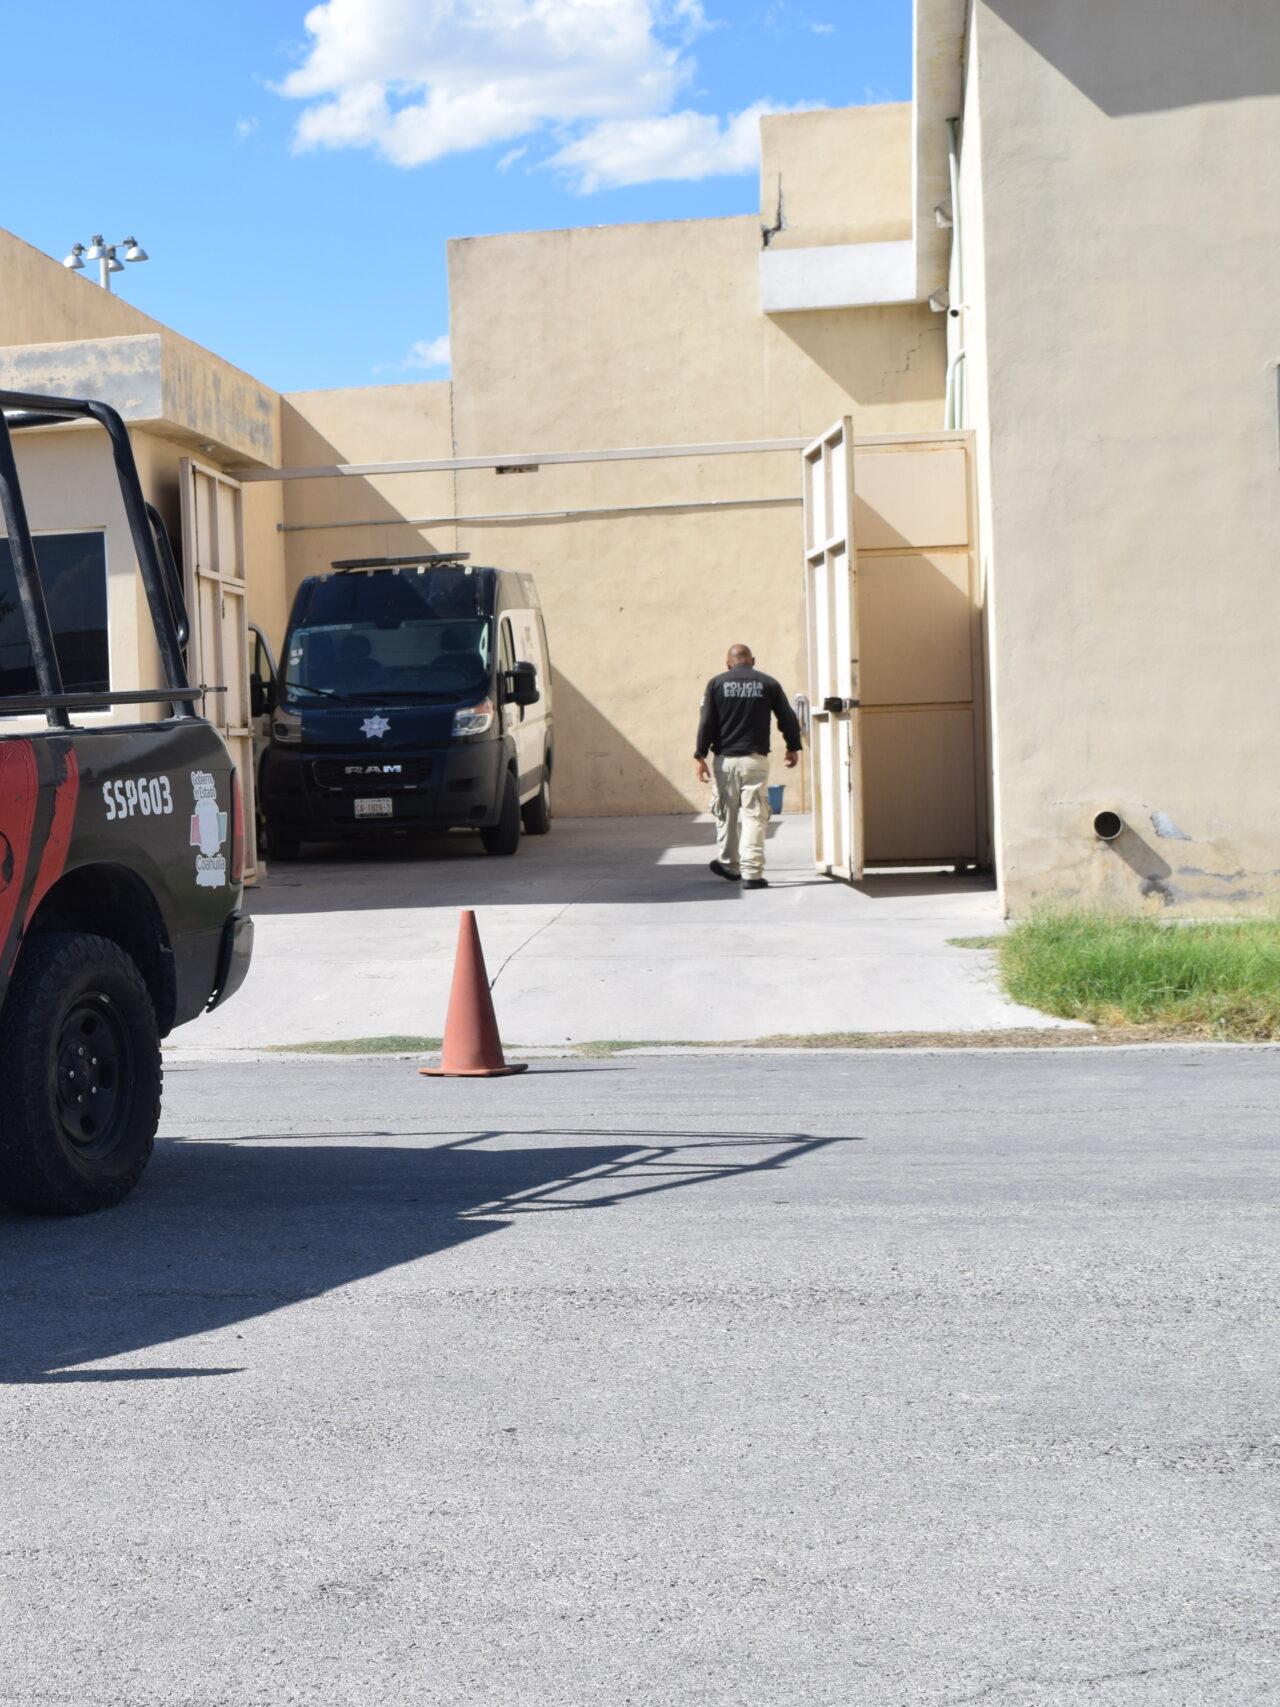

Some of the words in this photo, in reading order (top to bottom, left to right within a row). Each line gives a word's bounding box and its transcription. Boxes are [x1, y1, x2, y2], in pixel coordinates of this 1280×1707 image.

[723, 680, 763, 690] POLICÍA
[724, 689, 763, 697] ESTATAL
[345, 765, 402, 774] RAM
[103, 775, 173, 820] SSP603
[197, 855, 225, 871] Coahuila
